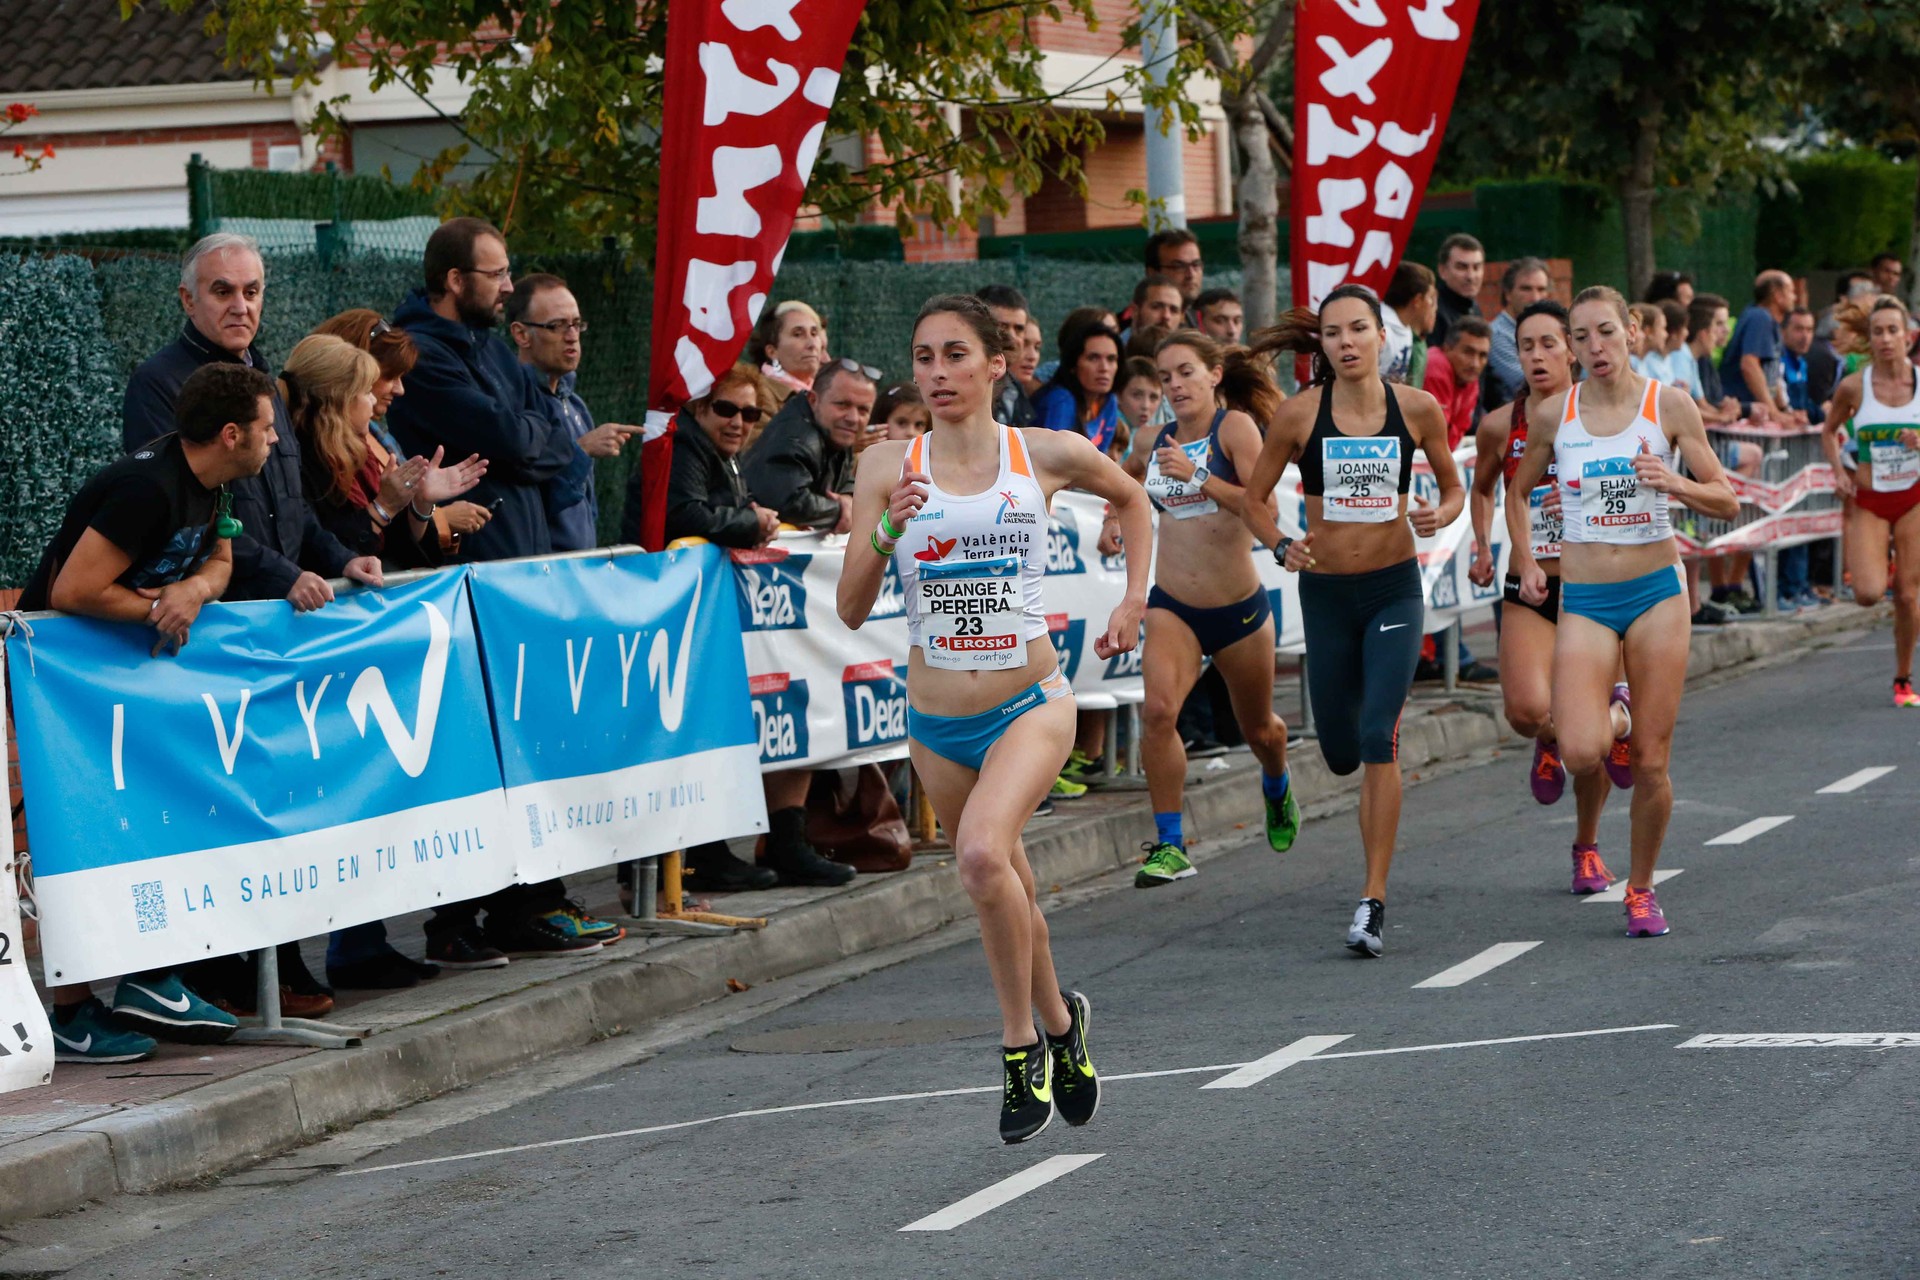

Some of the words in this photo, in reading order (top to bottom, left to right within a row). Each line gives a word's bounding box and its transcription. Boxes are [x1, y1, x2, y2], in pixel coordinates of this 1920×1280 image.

[1563, 441, 1593, 449] hummel
[1336, 463, 1390, 475] JOANNA
[1166, 485, 1184, 498] 28
[1350, 484, 1371, 497] 25
[1600, 489, 1637, 501] PERIZ
[1347, 498, 1390, 507] EROSKI
[1605, 500, 1626, 514] 29
[1604, 515, 1648, 525] EROSKI
[962, 531, 1030, 547] València
[963, 549, 995, 560] Terra
[1009, 547, 1029, 558] Mar
[922, 582, 998, 598] SOLANGE
[1001, 581, 1017, 597] A.
[930, 599, 1011, 614] PEREIRA
[954, 617, 983, 635] 23
[954, 638, 1014, 649] EROSKI
[973, 651, 1013, 666] contigo
[1002, 692, 1037, 715] hummel
[854, 681, 906, 743] Deia
[546, 811, 559, 833] LA
[567, 801, 614, 829] SALUD
[624, 798, 638, 819] EN
[648, 792, 661, 813] TU
[184, 884, 215, 912] LA
[241, 864, 318, 903] SALUD
[338, 855, 359, 883] EN
[376, 845, 396, 873] TU
[414, 828, 485, 863] MÓVIL
